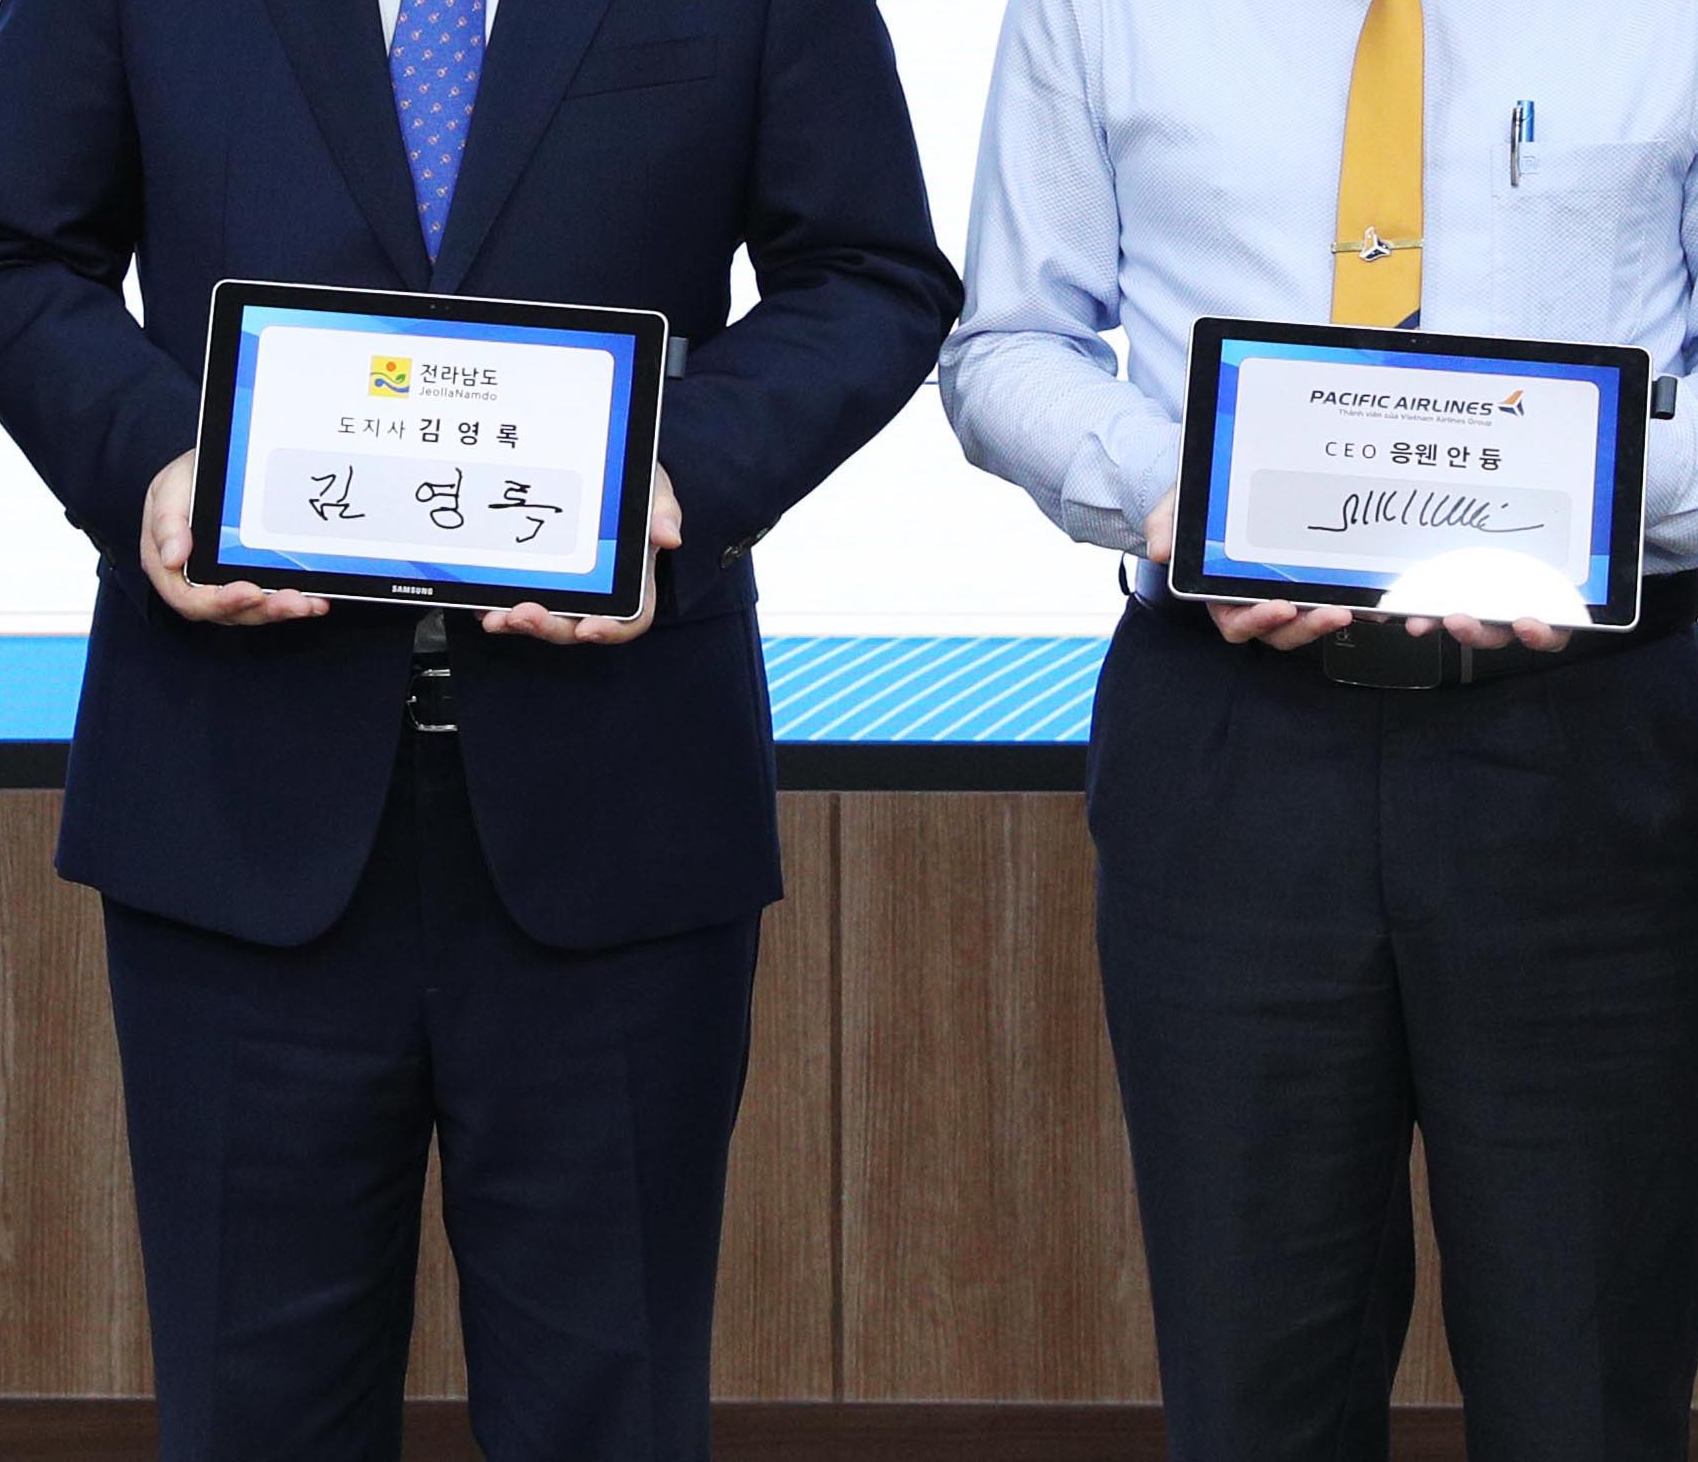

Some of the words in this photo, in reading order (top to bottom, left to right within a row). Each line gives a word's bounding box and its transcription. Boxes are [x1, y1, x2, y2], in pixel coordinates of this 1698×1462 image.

[420, 364, 499, 387] 전라남도
[418, 386, 498, 401] JeollaNamdo
[1310, 390, 1391, 409] PACIFIC
[1394, 396, 1493, 416] AIRLINES
[391, 583, 434, 596] SAMSUNG
